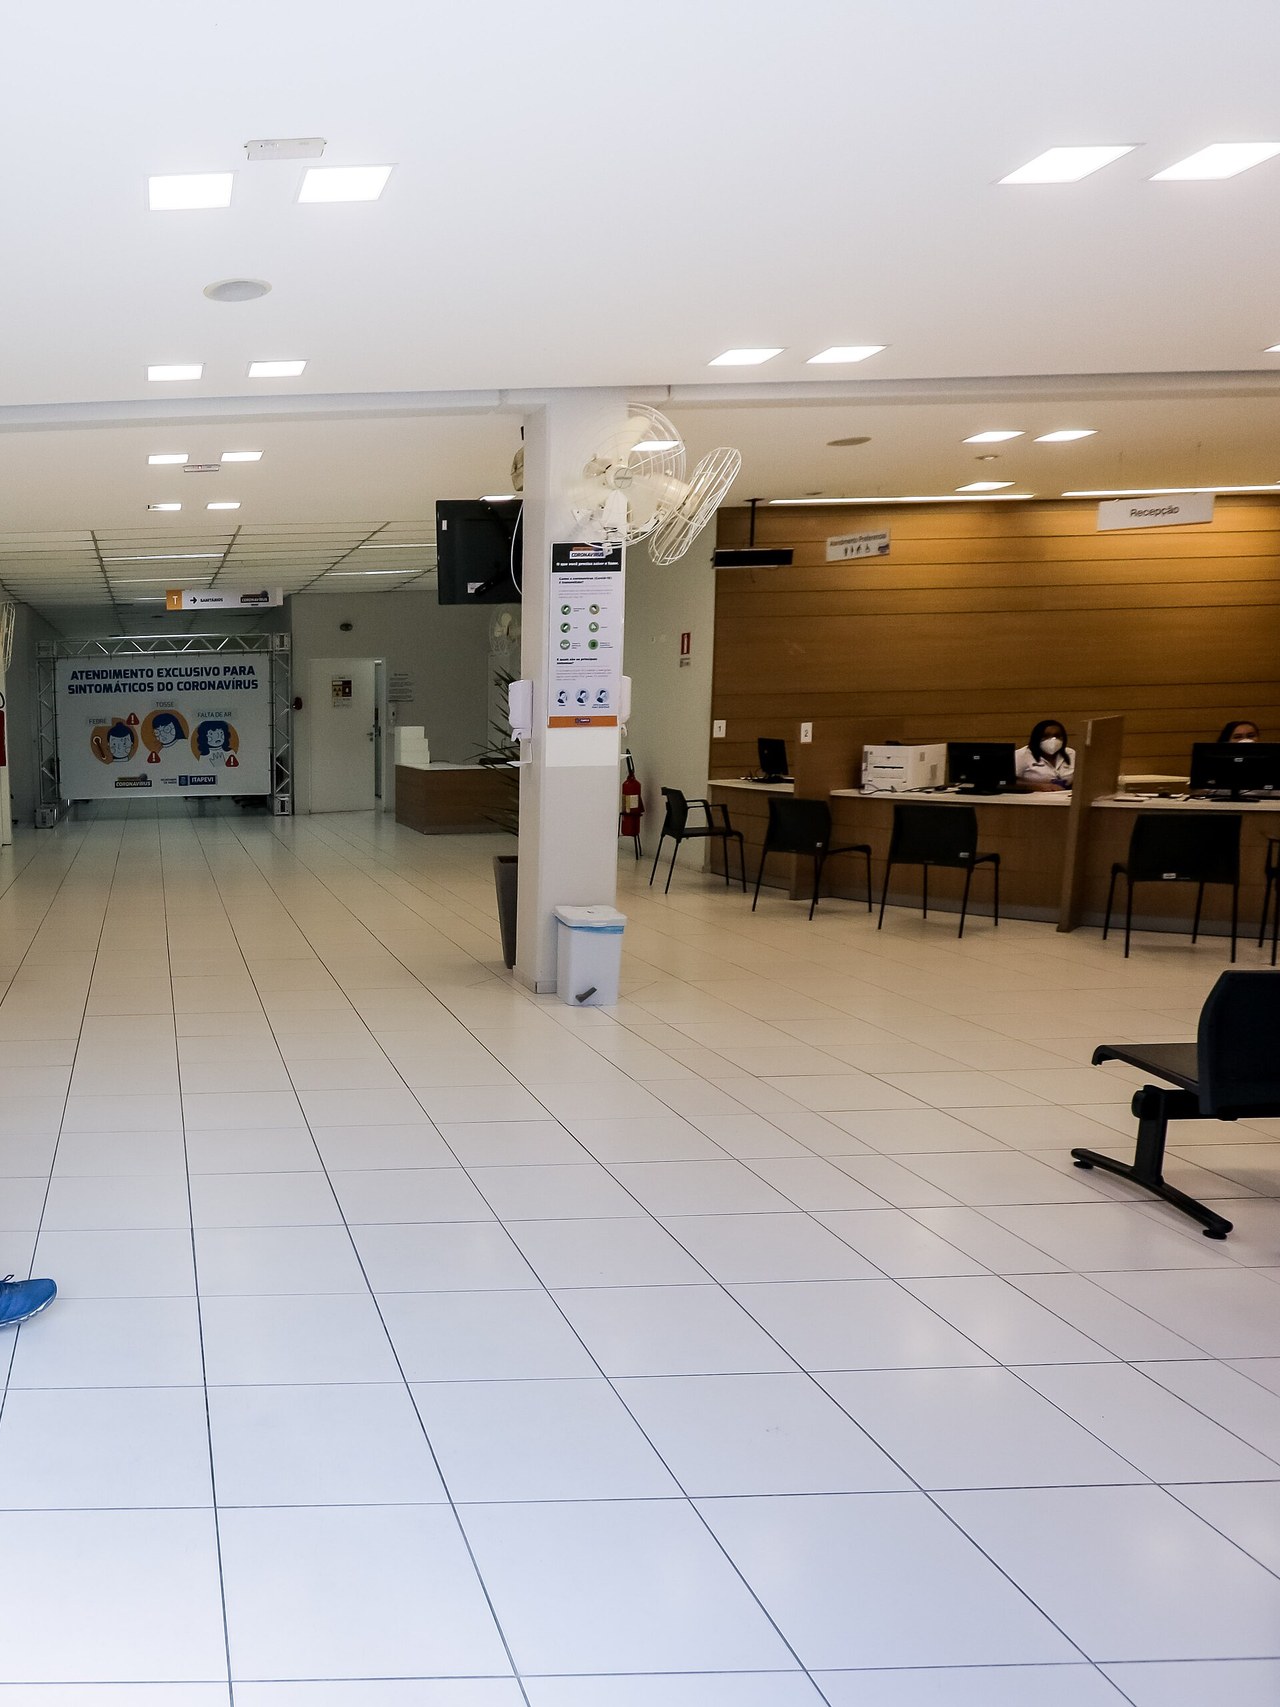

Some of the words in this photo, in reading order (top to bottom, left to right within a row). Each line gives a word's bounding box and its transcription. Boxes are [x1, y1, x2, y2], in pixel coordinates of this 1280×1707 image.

[1129, 505, 1180, 517] Recepção
[70, 668, 154, 680] ATENDIMENTO
[156, 666, 220, 678] EXCLUSIVO
[222, 665, 256, 676] PARA
[68, 680, 154, 694] SINTOMÁTICOS
[157, 681, 174, 692] DO
[176, 677, 259, 691] CORONAVÍRUS
[804, 729, 809, 738] 2
